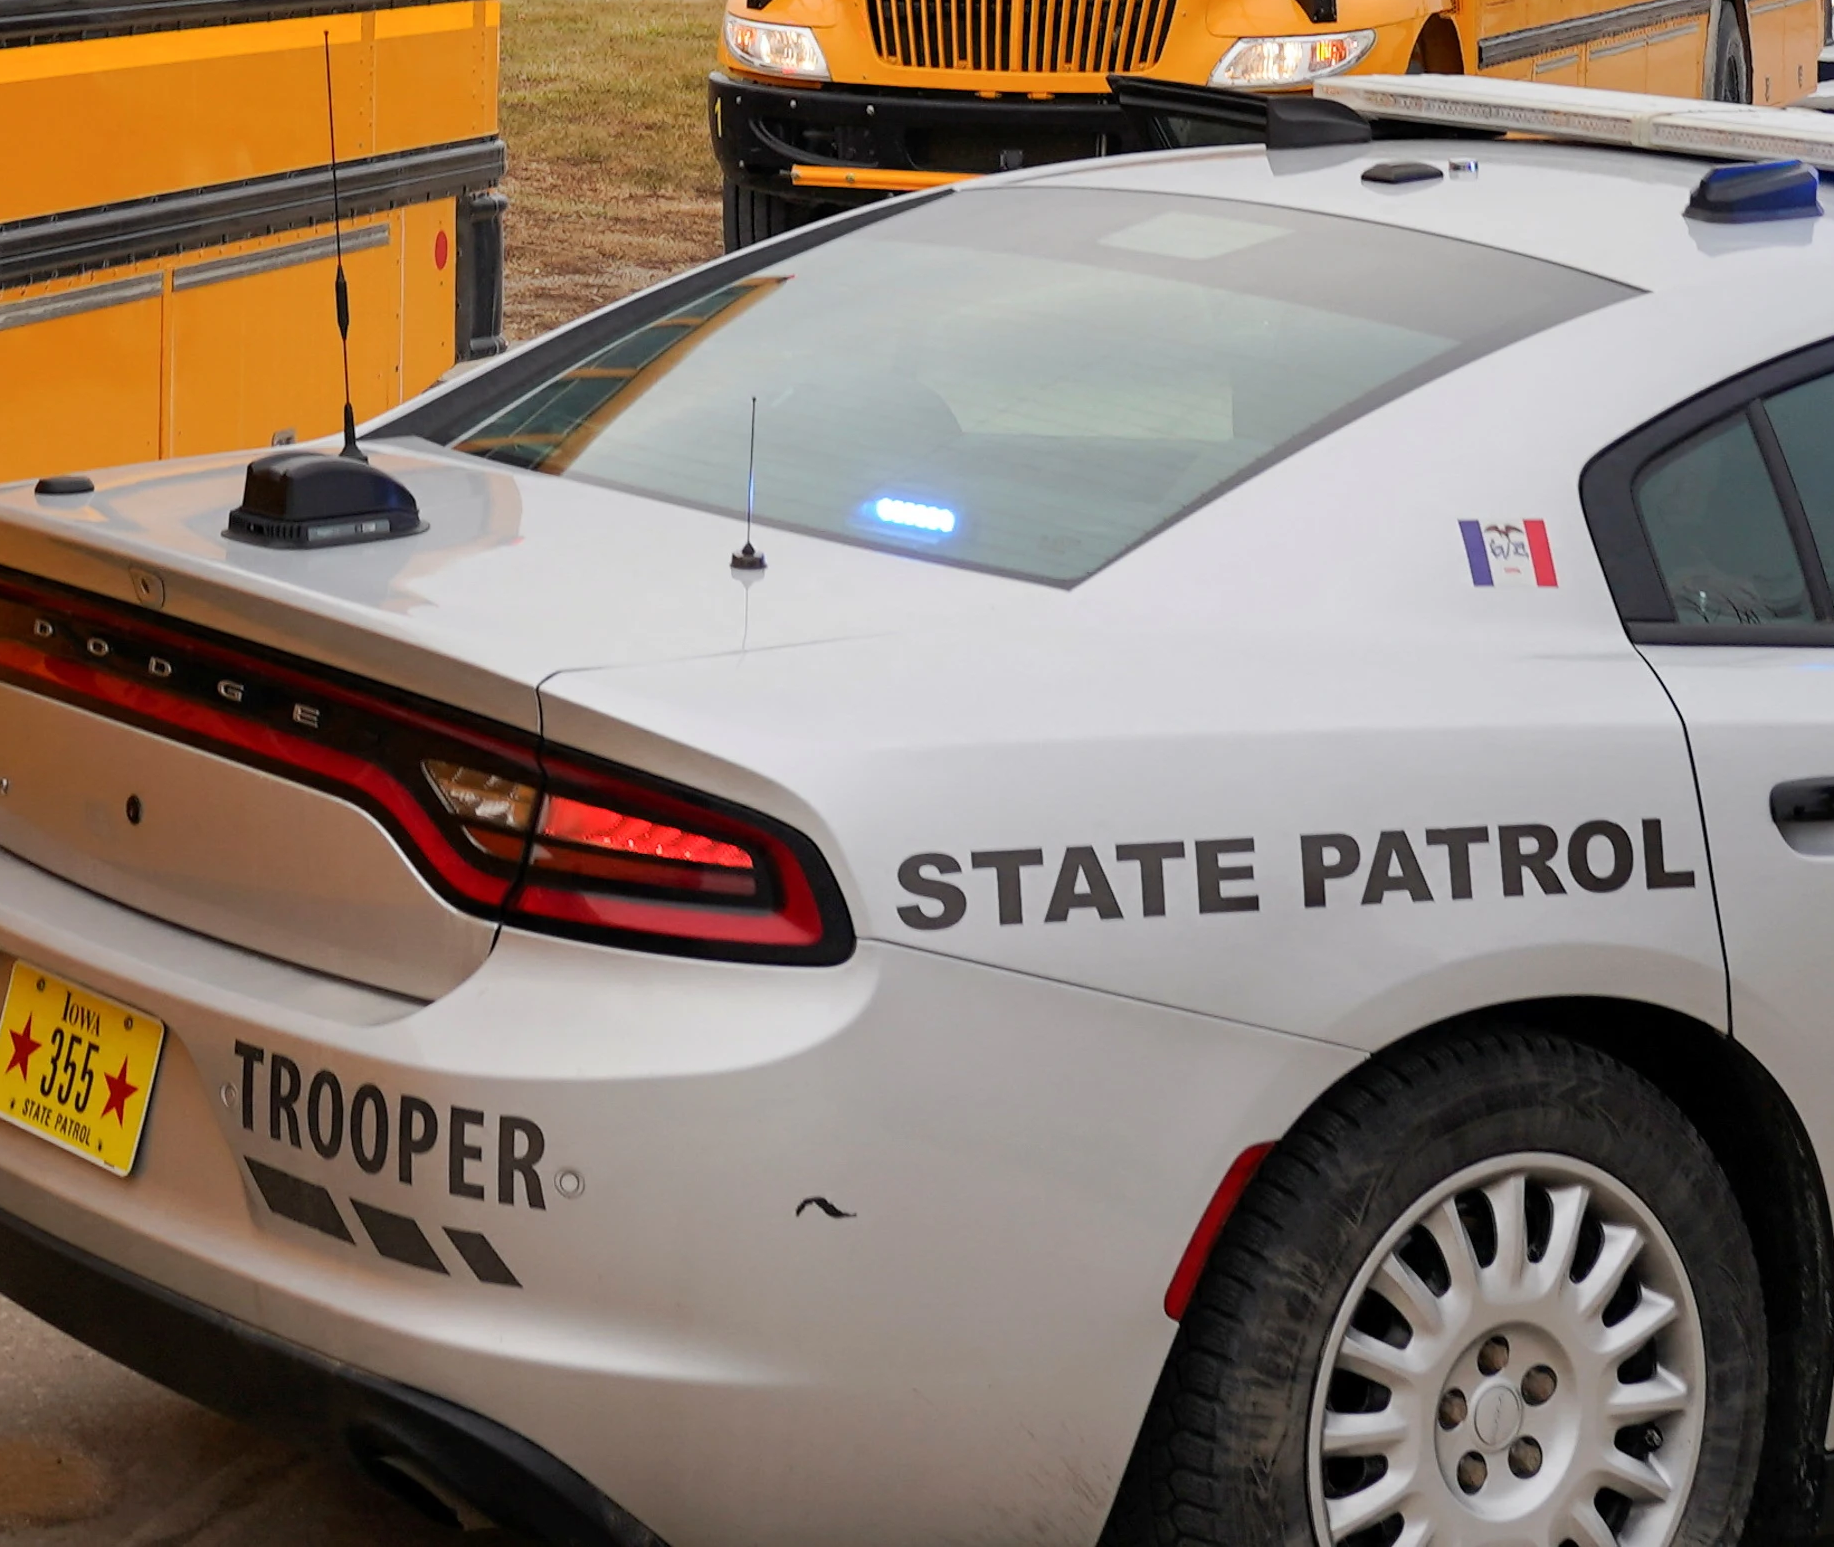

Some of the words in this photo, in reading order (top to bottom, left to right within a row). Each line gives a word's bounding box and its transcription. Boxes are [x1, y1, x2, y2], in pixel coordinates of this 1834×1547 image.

[34, 618, 320, 728] DODGE
[895, 837, 1260, 931] STATE
[1300, 818, 1696, 909] PATROL
[21, 1098, 53, 1127] STATE
[54, 1113, 92, 1147] PATROL
[40, 1026, 100, 1113] 355
[234, 1039, 547, 1211] TROOPER
